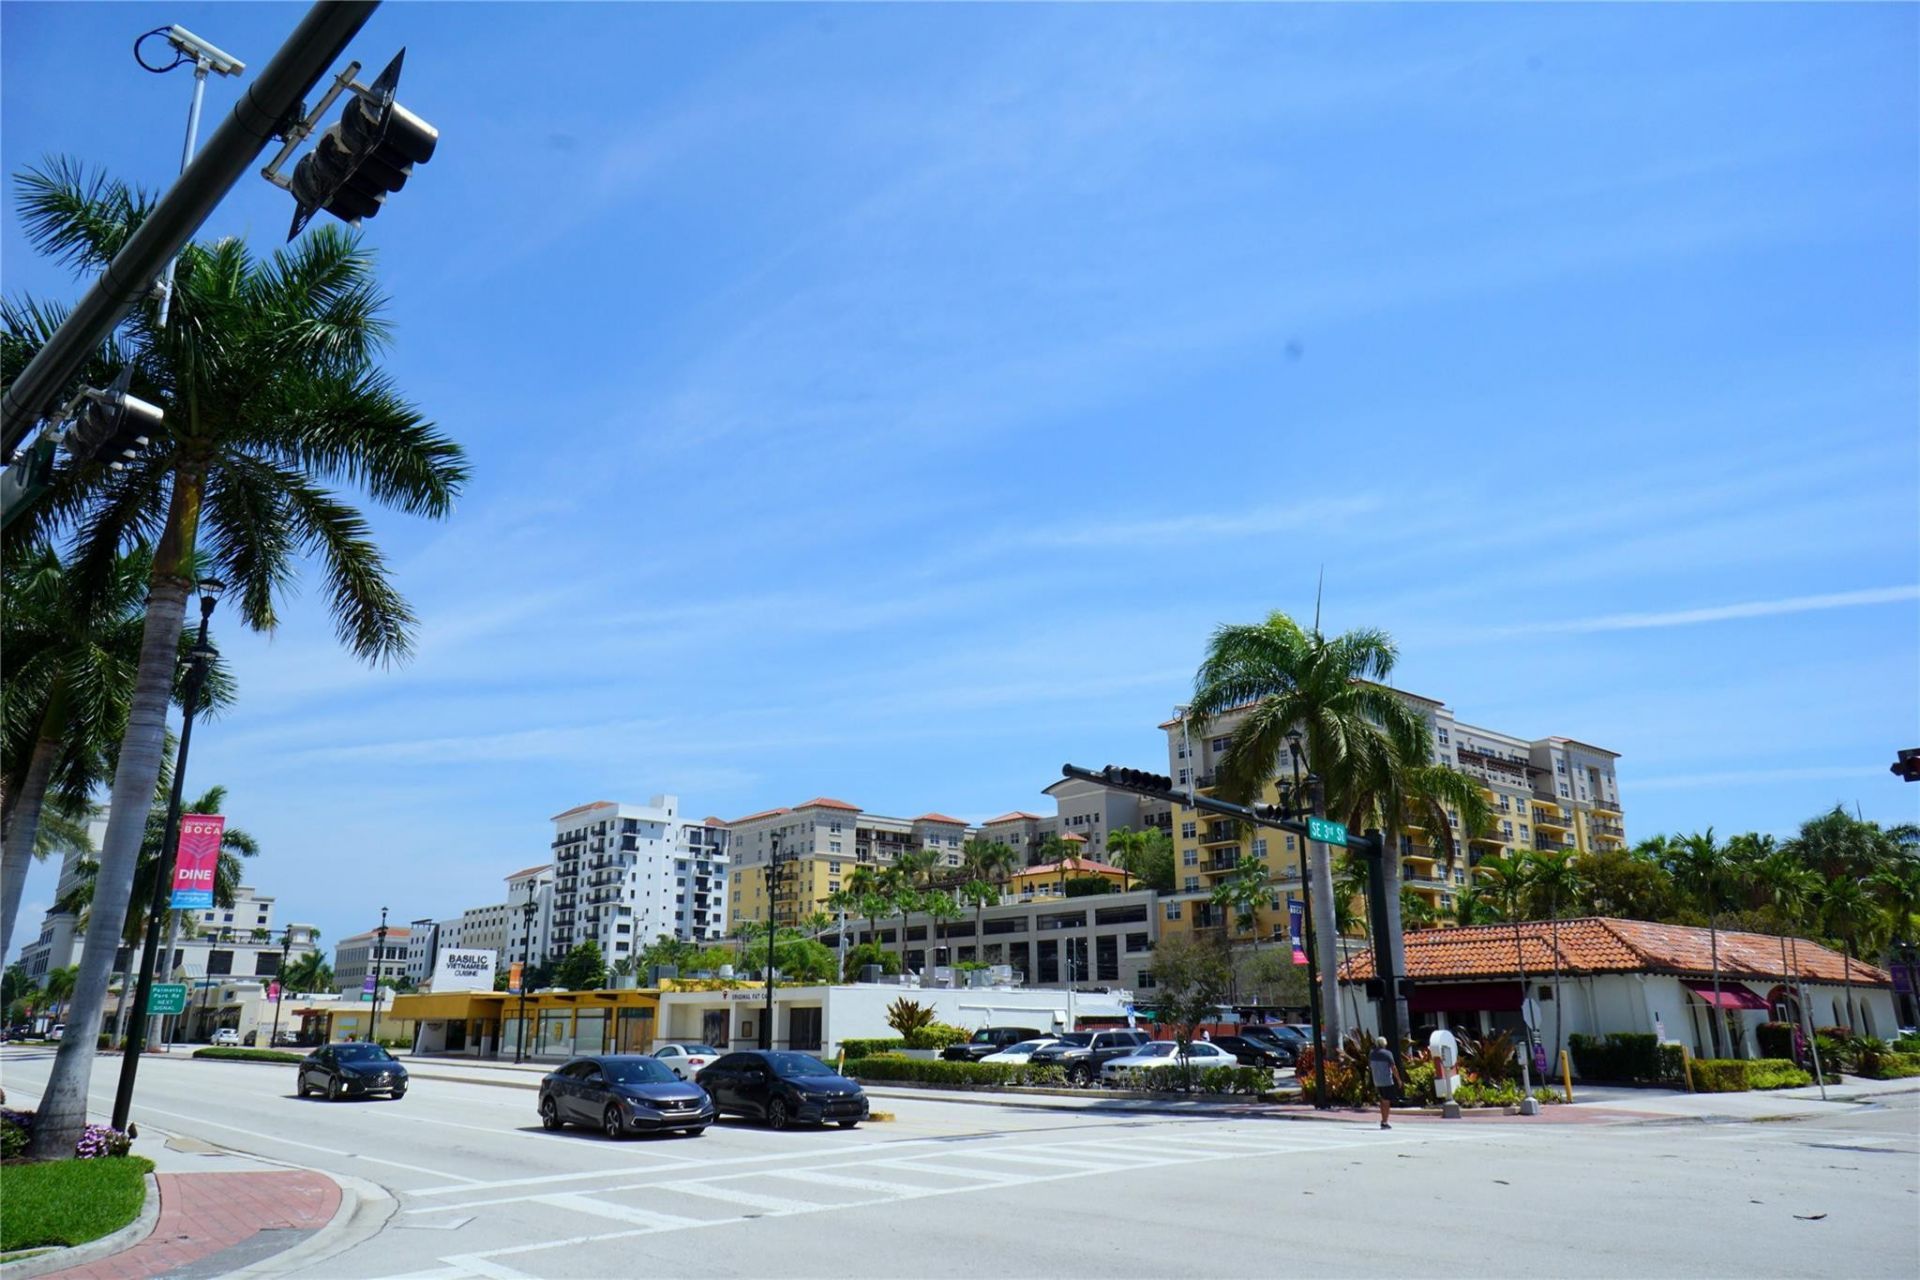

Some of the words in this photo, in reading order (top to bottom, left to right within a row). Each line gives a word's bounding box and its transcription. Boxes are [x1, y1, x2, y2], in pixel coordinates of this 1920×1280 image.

[184, 826, 220, 834] BOCA
[1311, 821, 1321, 838] SE
[179, 868, 212, 880] DINE
[449, 954, 488, 964] BASILIC
